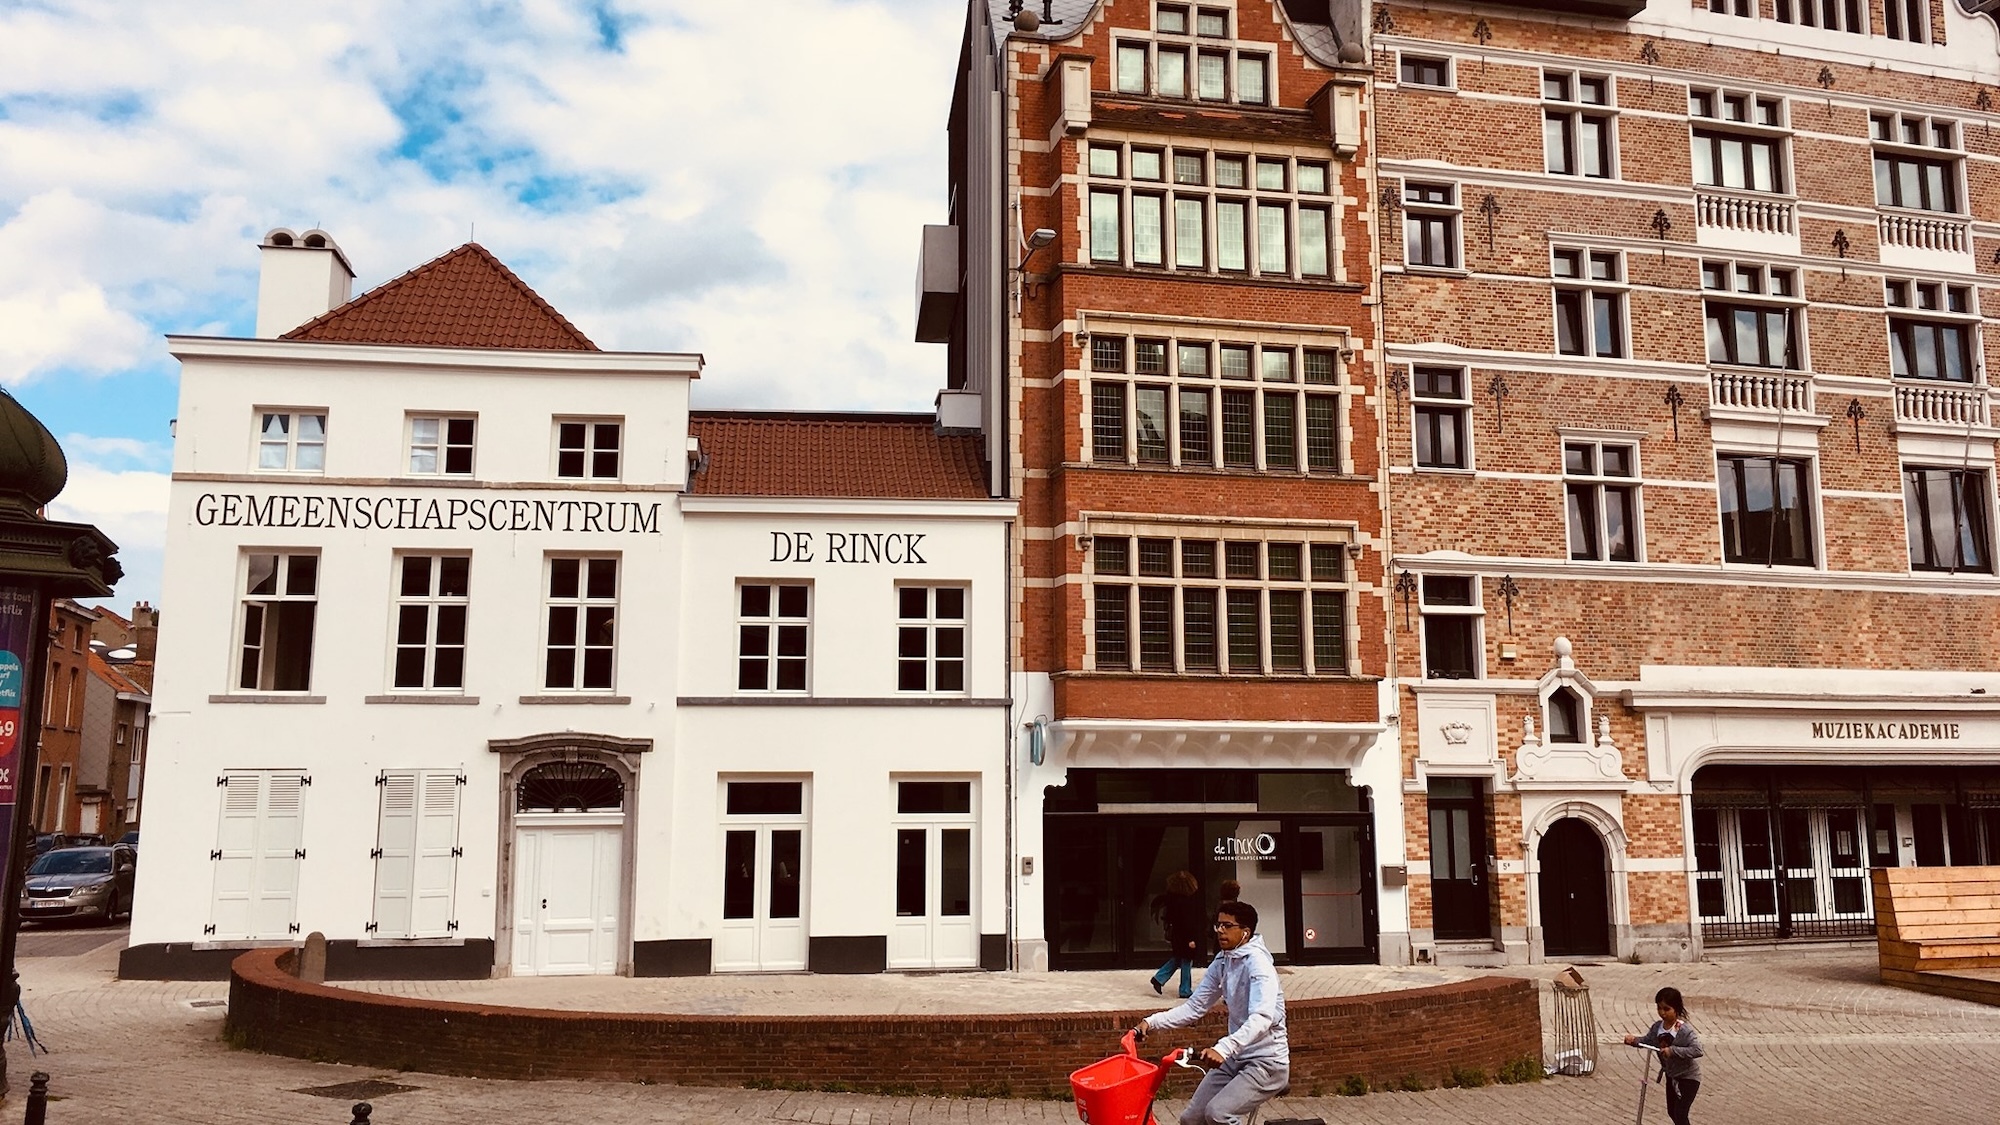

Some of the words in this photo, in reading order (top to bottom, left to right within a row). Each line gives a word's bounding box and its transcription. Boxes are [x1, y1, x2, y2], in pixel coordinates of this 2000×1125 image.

[195, 493, 661, 534] GEMEENSCHAPSCENTRUM
[770, 531, 814, 563] DE
[825, 532, 927, 564] RINCK
[12, 592, 31, 603] tout
[1811, 722, 1960, 740] MUZIEKACADEMIE
[1214, 838, 1226, 855] de
